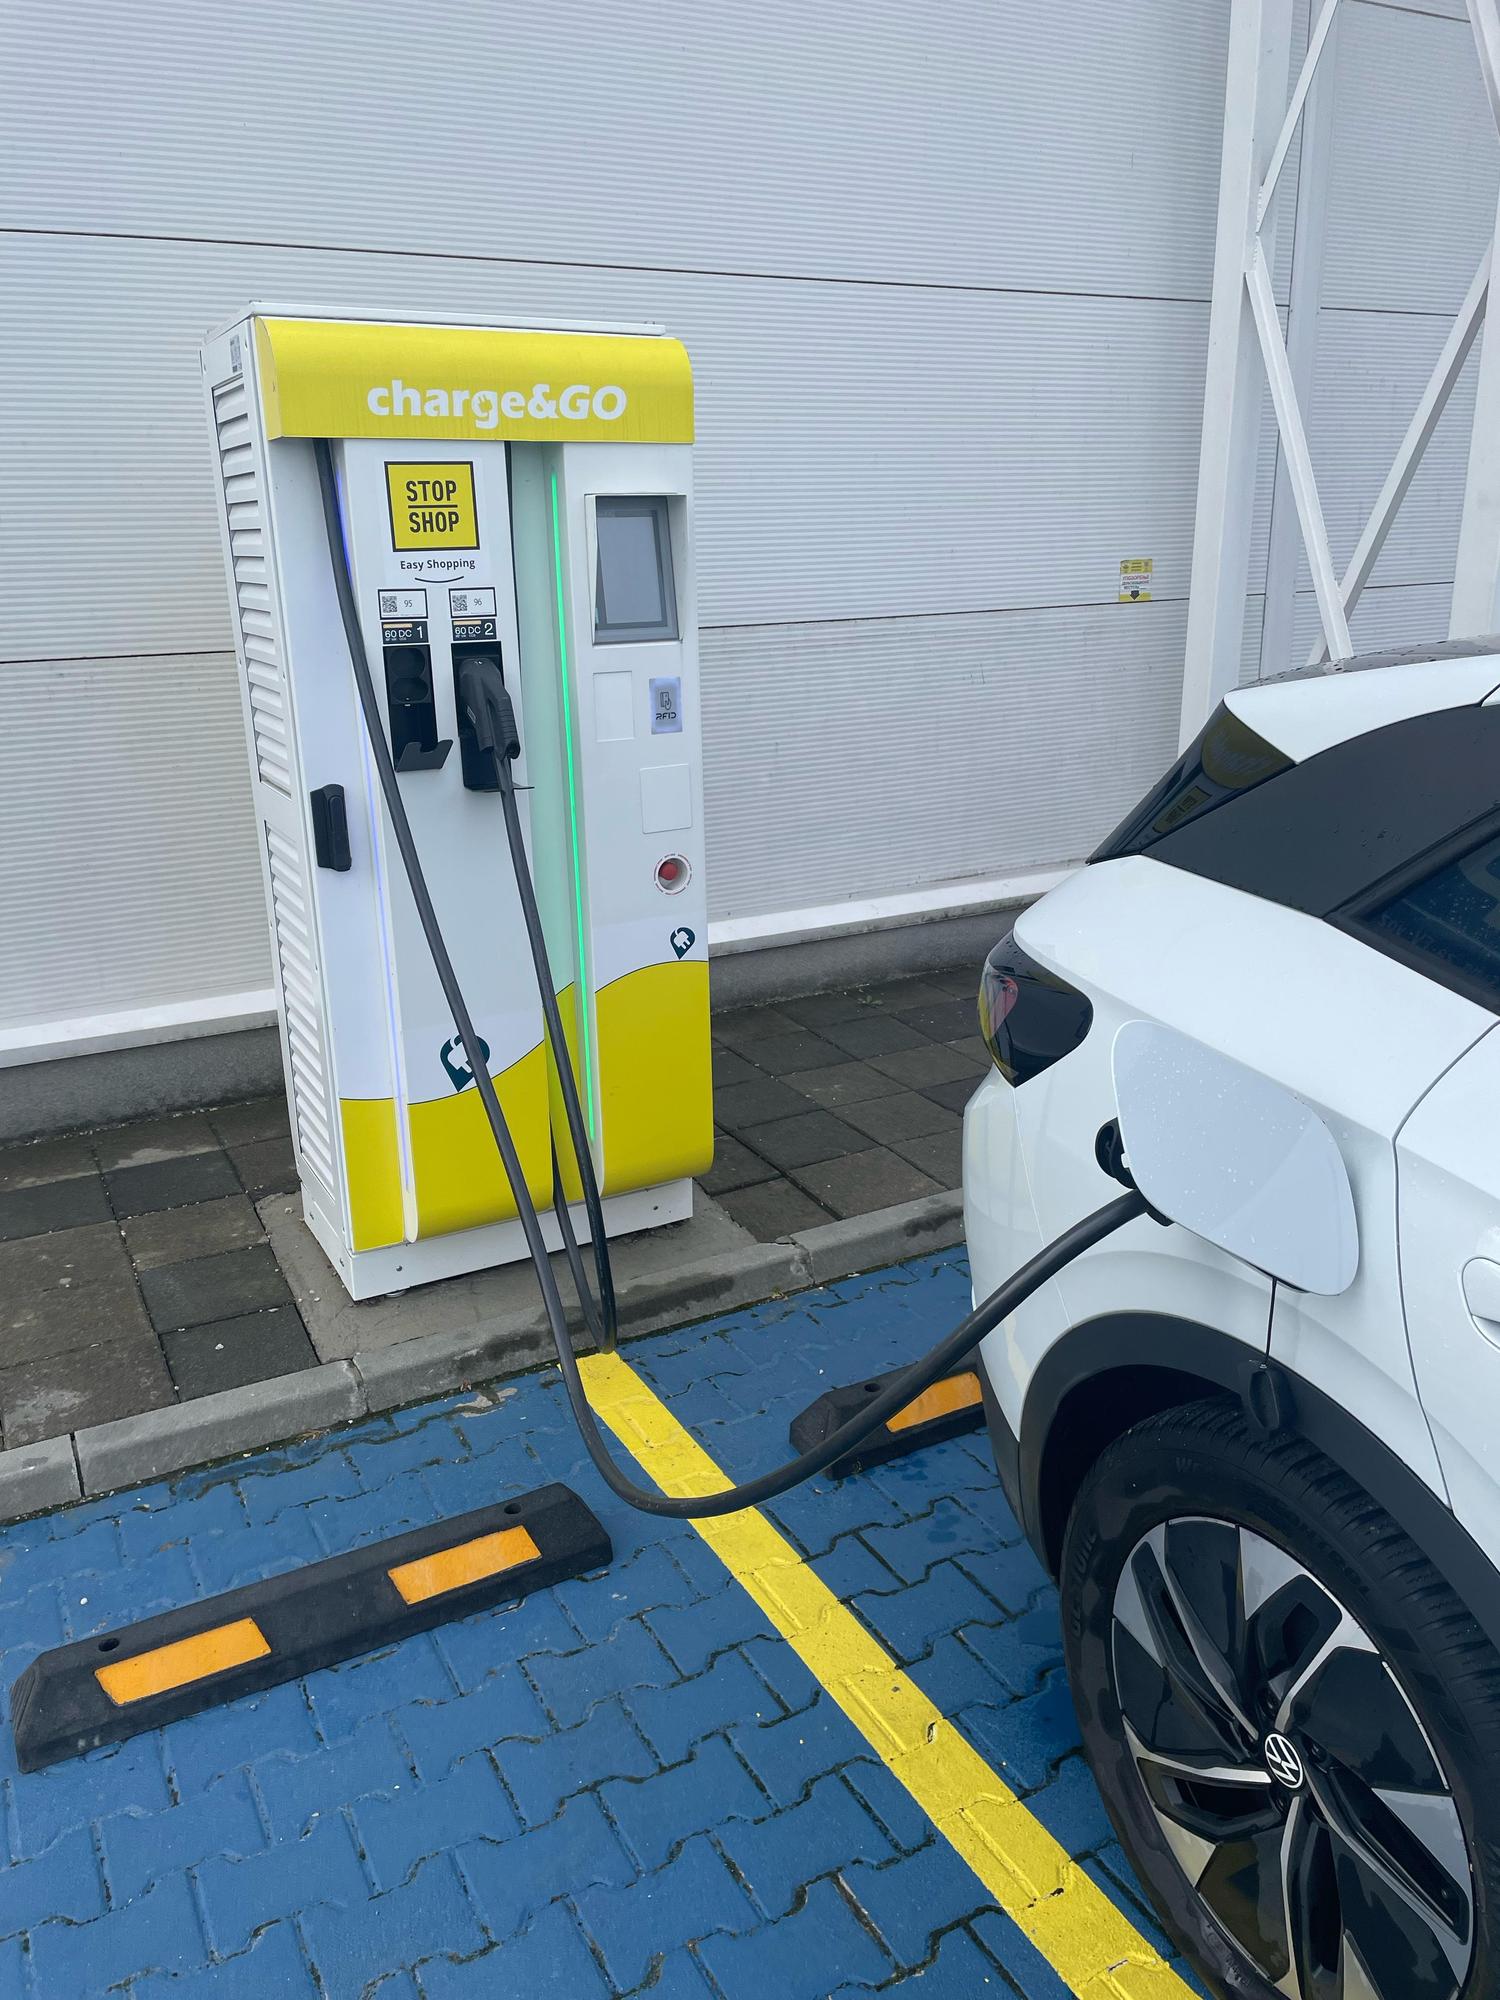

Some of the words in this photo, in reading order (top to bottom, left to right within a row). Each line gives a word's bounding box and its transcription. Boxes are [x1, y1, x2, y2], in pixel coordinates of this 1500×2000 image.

[367, 379, 627, 429] charge&GO
[405, 480, 457, 502] STOP
[408, 511, 460, 534] SHOP
[400, 560, 424, 571] Easy
[427, 558, 476, 571] Shopping
[404, 600, 413, 608] 95
[473, 598, 482, 606] 96
[384, 630, 397, 638] 60
[398, 629, 412, 638] DC
[416, 625, 423, 639] 1
[454, 626, 467, 635] 60
[467, 626, 481, 635] DC
[484, 622, 494, 636] 2
[655, 711, 677, 720] RFID
